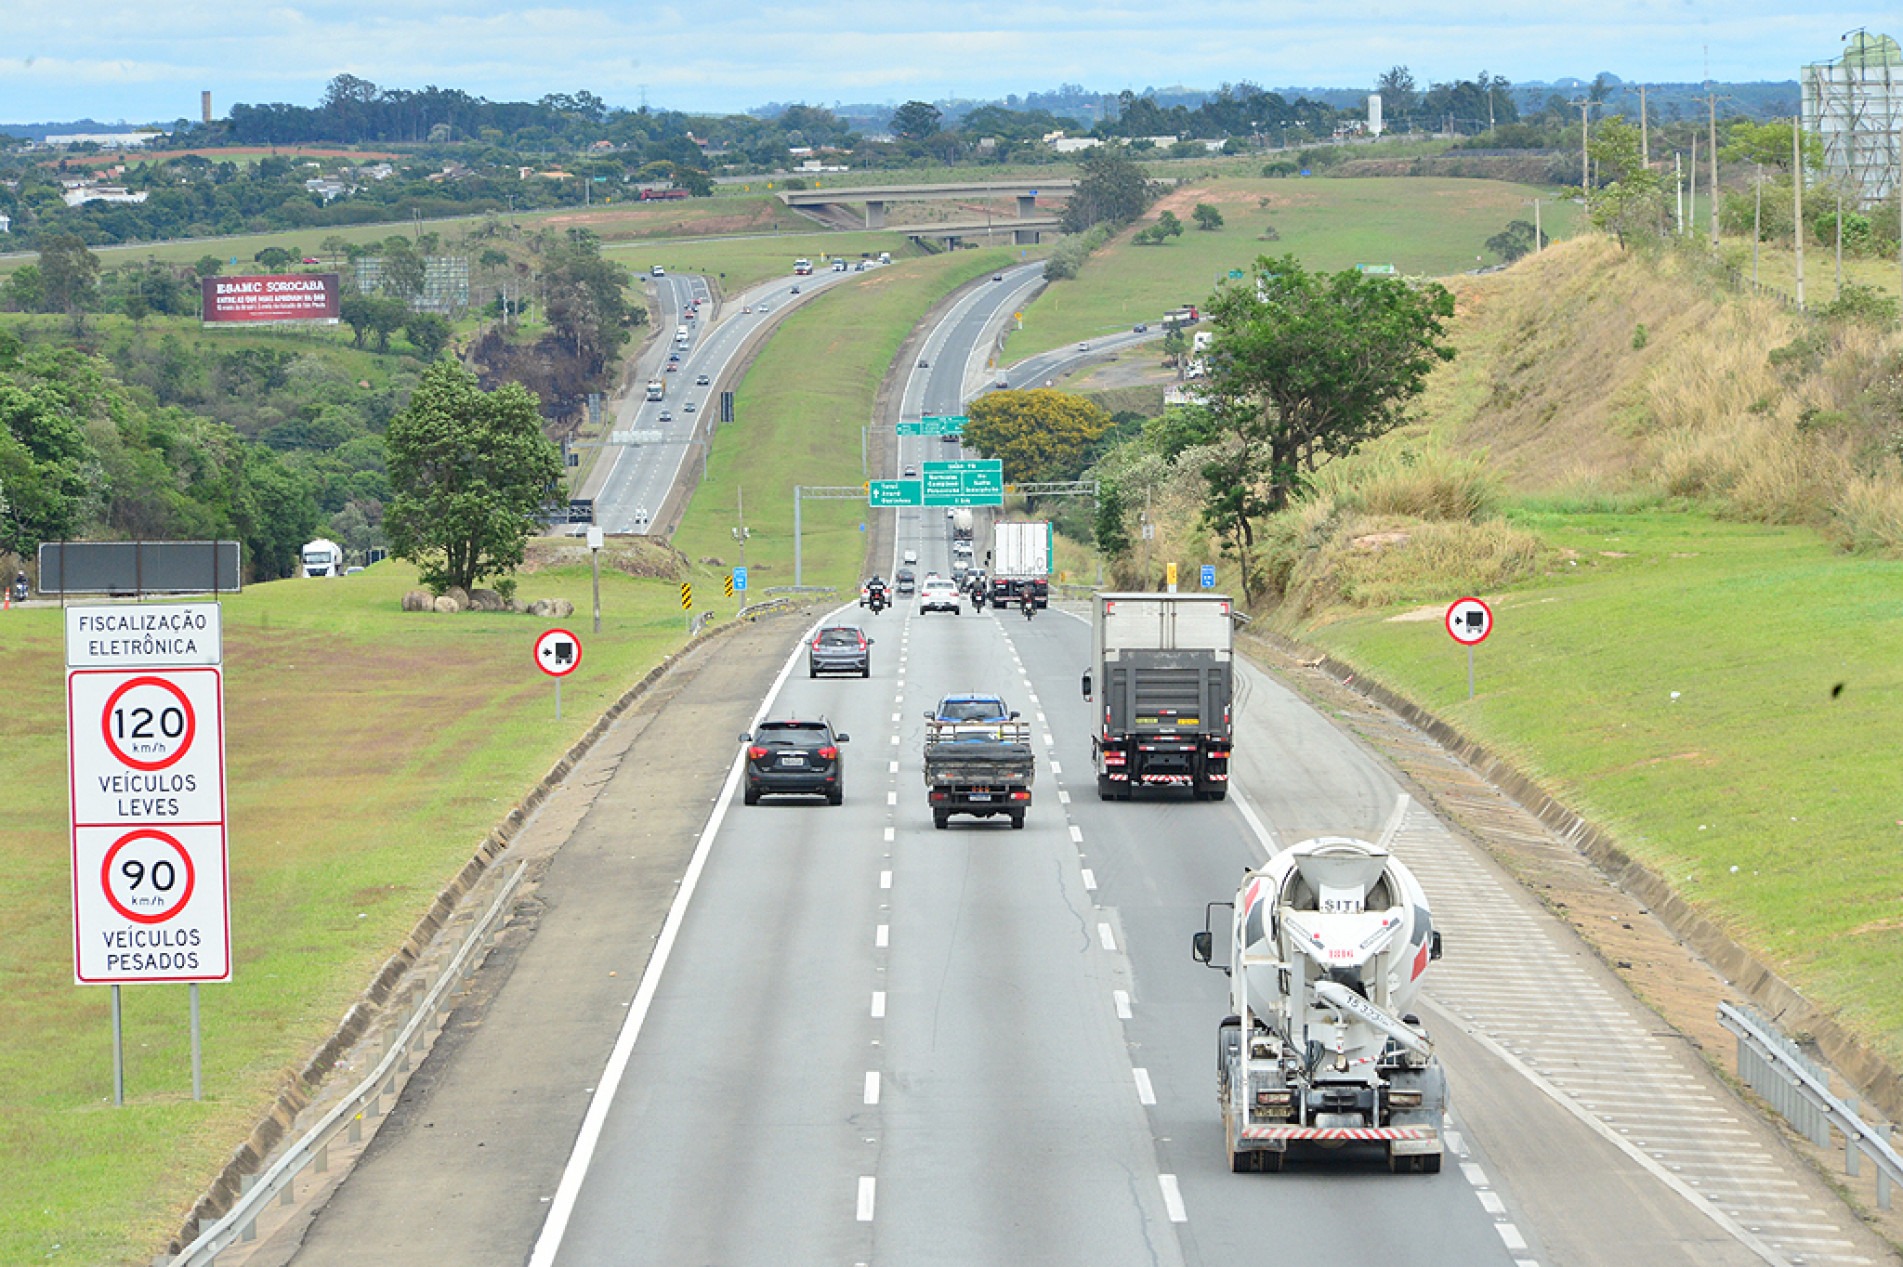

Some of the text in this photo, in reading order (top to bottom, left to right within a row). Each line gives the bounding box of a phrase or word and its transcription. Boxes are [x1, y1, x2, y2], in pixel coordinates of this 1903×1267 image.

[216, 280, 325, 294] ESAMC SOROCABA
[79, 609, 207, 633] FISCALIZAÇÃO
[88, 633, 198, 656] ELETRÔNICA
[114, 707, 185, 739] 120
[132, 742, 166, 753] km/h
[98, 771, 197, 793] VEÍCULOS
[118, 799, 179, 816] LEVES
[121, 860, 176, 891] 90
[131, 895, 164, 906] km/h
[1324, 900, 1360, 912] SITI
[102, 925, 201, 948] VEÍCULOS
[107, 952, 199, 971] PESADOS
